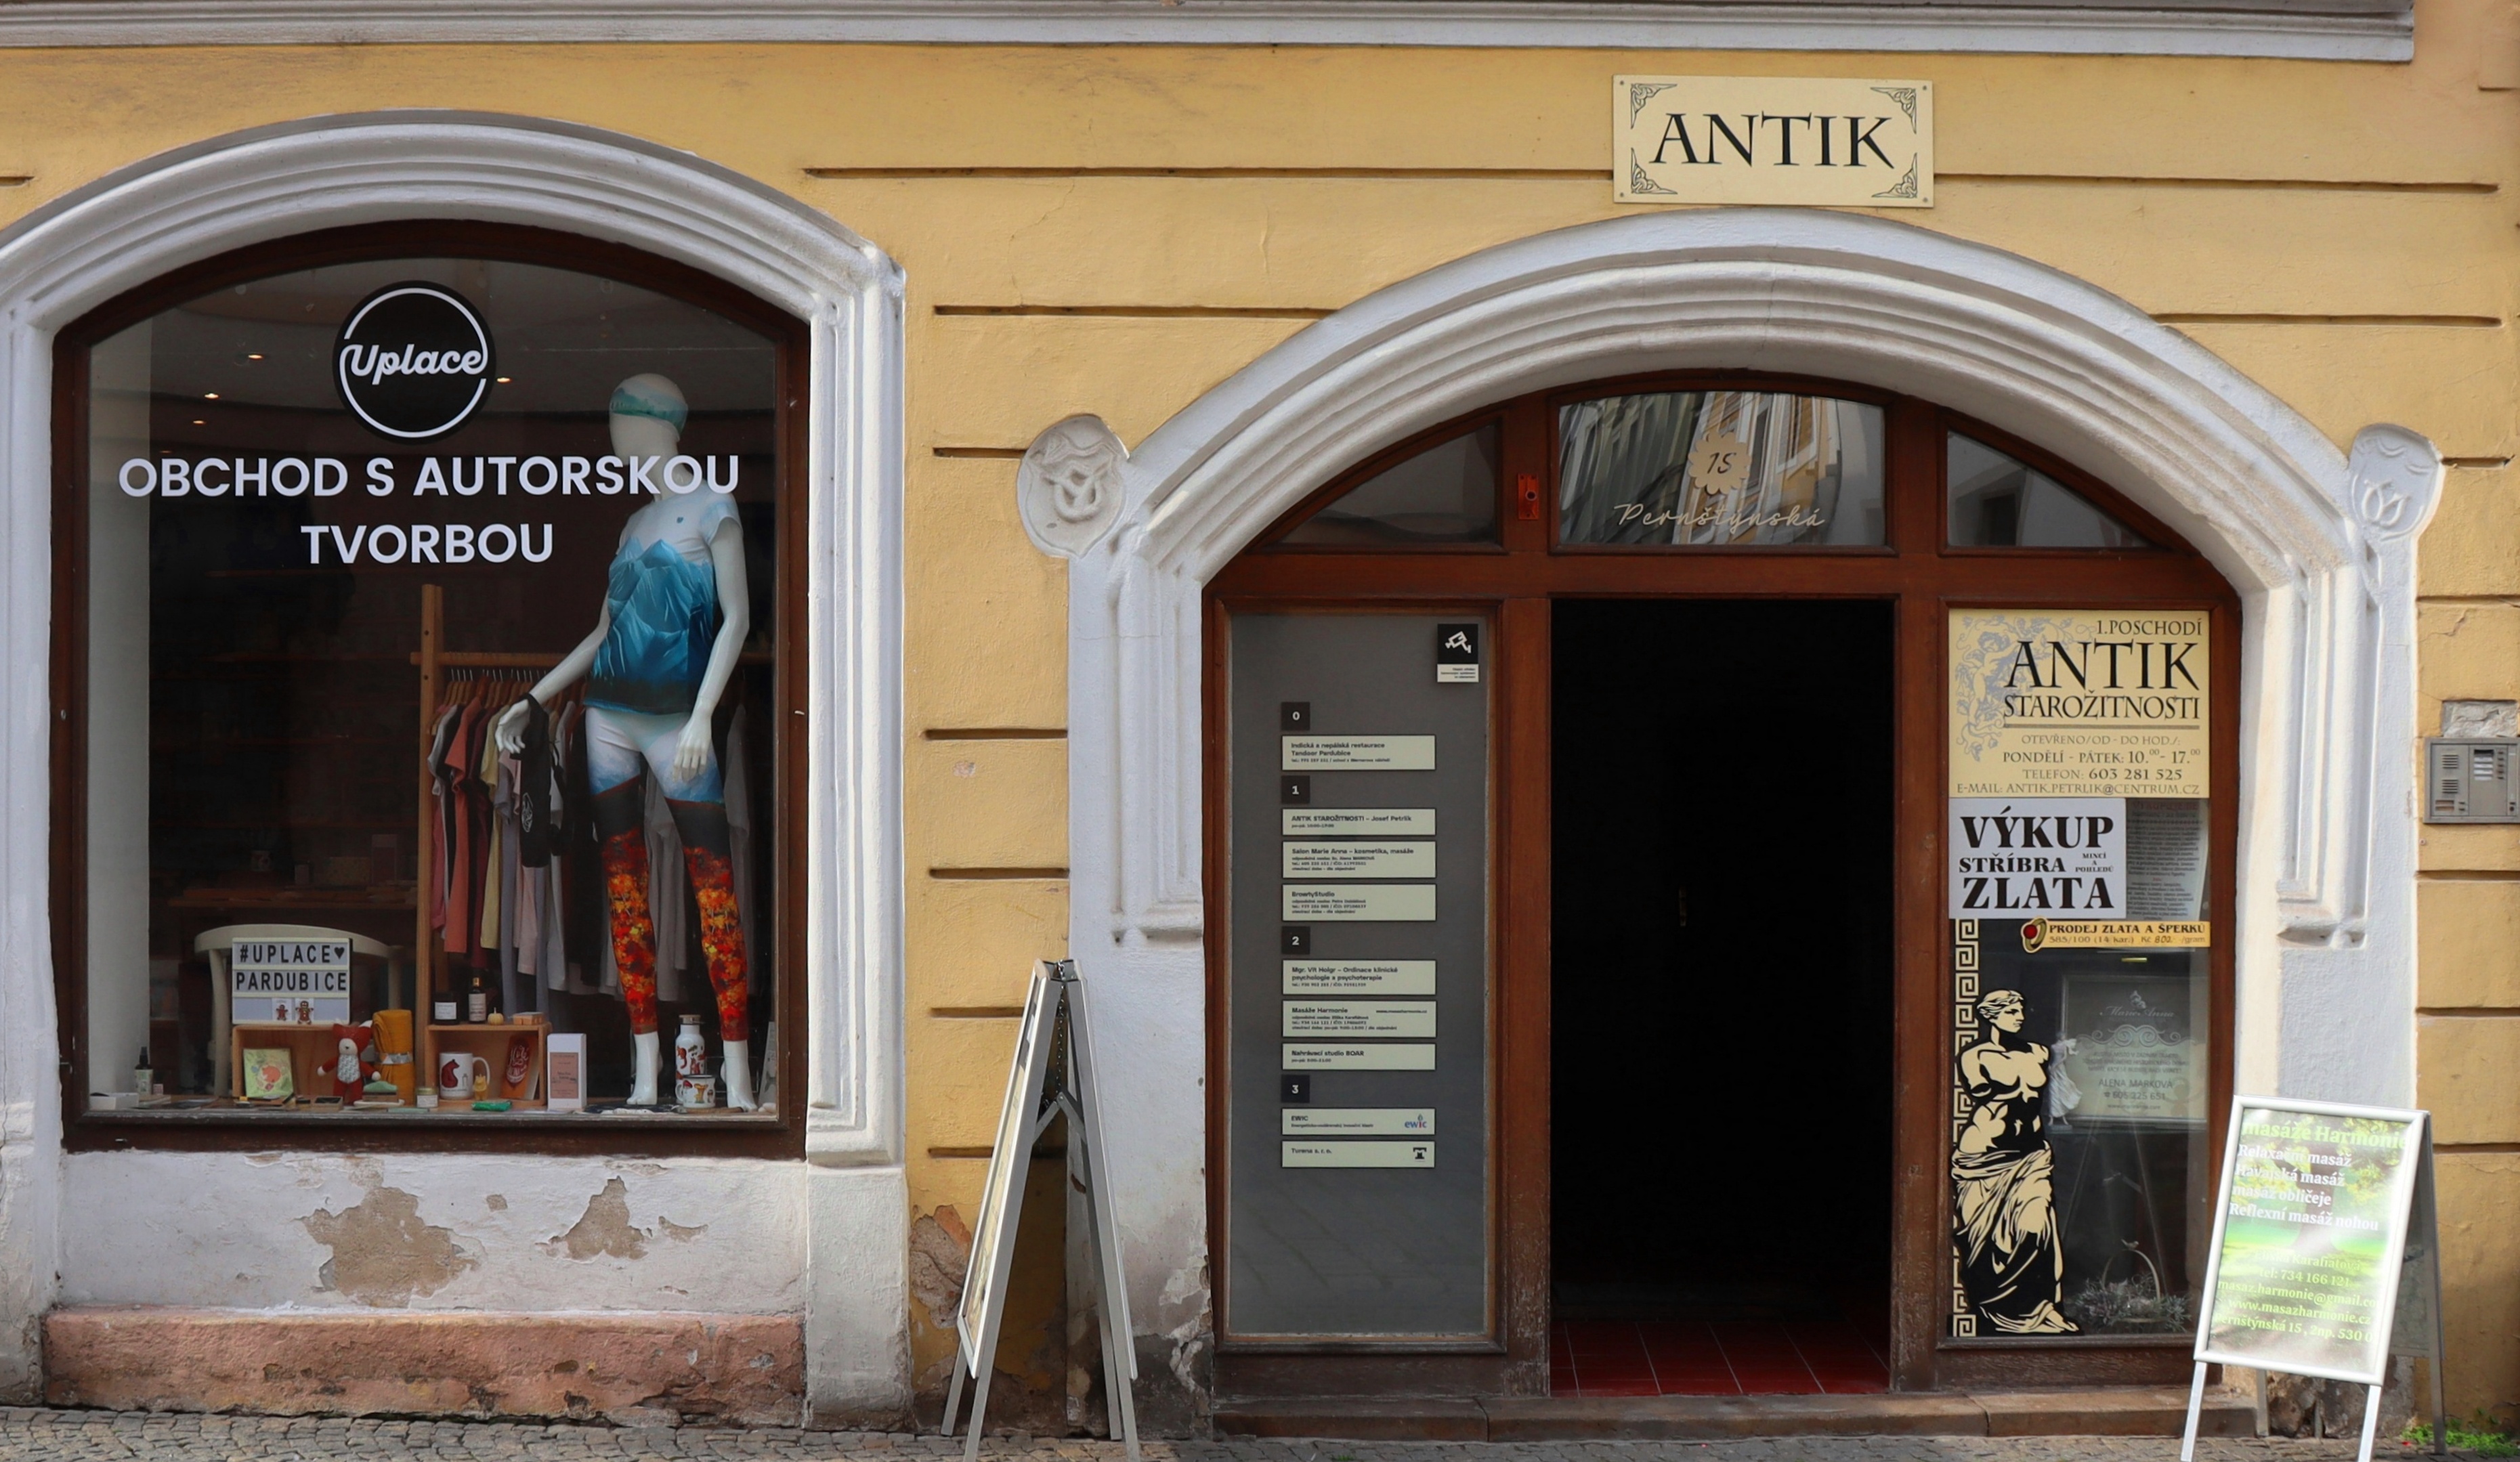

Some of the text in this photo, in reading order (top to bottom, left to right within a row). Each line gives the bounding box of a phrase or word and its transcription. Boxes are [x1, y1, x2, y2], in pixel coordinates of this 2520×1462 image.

[1649, 111, 1894, 169] ANTIK
[341, 344, 487, 385] Uplace
[119, 454, 739, 497] OBCHOD S AUTORSKOU
[1613, 503, 1826, 534] Pernštýnská
[301, 523, 553, 565] TVORBOU
[2097, 618, 2202, 636] 1.POSCHODÍ
[2004, 639, 2200, 691] ANTIK
[2003, 689, 2200, 720] STAROŽITNOSTI
[1293, 711, 1300, 721] 0
[1321, 742, 1349, 750] nepálská
[2120, 736, 2139, 746] DO
[2003, 750, 2064, 764] PONDĚLÍ
[2079, 750, 2124, 764] PÁTEK:
[2022, 769, 2182, 781] TELEFON: 603 281 525
[1292, 786, 1299, 795] 1
[1957, 783, 2003, 794] E-MAIL:
[1960, 805, 2114, 848] VÝKUP
[1959, 853, 2066, 874] STŘÍBRA
[1962, 877, 2114, 909] ZLATA
[2049, 922, 2205, 934] PRODEJ ZLATA A ŠPERKŮ
[1292, 937, 1299, 946] 2
[240, 944, 330, 964] #UPLACE
[236, 972, 347, 991] PARDUBICE
[1292, 1085, 1299, 1094] 3
[2099, 1078, 2173, 1089] ALENA MARKOVÁ
[2242, 1121, 2406, 1149] masáže Harmonie
[2308, 1152, 2352, 1167] masáž
[2301, 1172, 2345, 1187] masáž
[2232, 1185, 2332, 1207] masáž obličeje
[2229, 1203, 2378, 1230] Reflexní masáž nohou
[2260, 1269, 2350, 1287] tel: 734 166 121
[2218, 1279, 2378, 1308] masaz.harmonie@gmail.co
[2229, 1299, 2371, 1325] www.masazharmonie.cz
[2288, 1323, 2302, 1333] 15
[2311, 1325, 2335, 1340] 2np.
[2338, 1328, 2362, 1342] 530
[2364, 1332, 2374, 1343] 0
